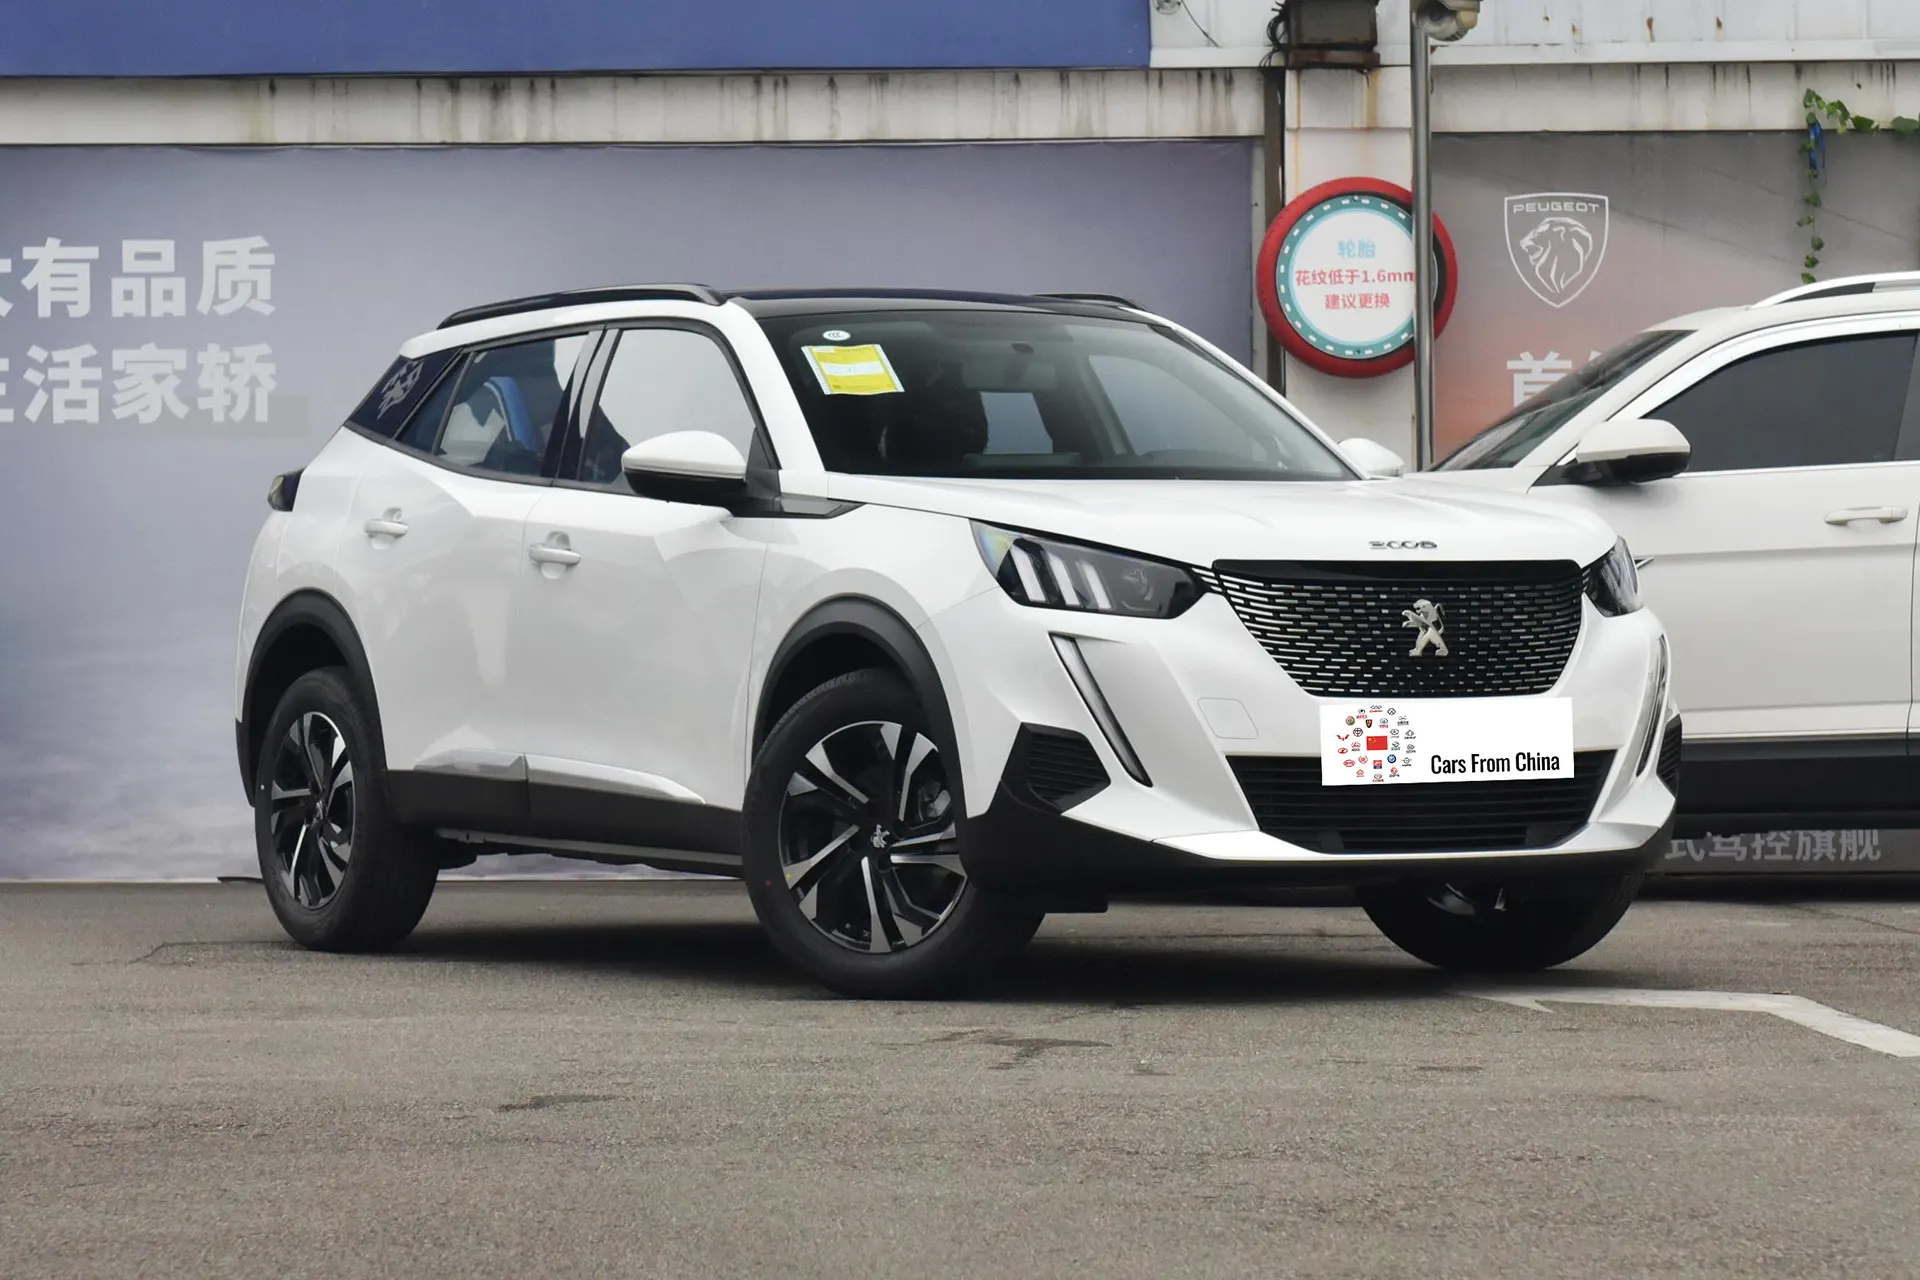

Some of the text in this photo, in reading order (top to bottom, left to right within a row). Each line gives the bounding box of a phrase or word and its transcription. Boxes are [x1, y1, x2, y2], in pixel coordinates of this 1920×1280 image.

[1513, 201, 1600, 213] PEUGEOT
[1337, 239, 1376, 259] 轮胎
[0, 235, 276, 318] 有品质
[1325, 292, 1390, 310] 建议更换
[0, 342, 278, 424] 活家轿
